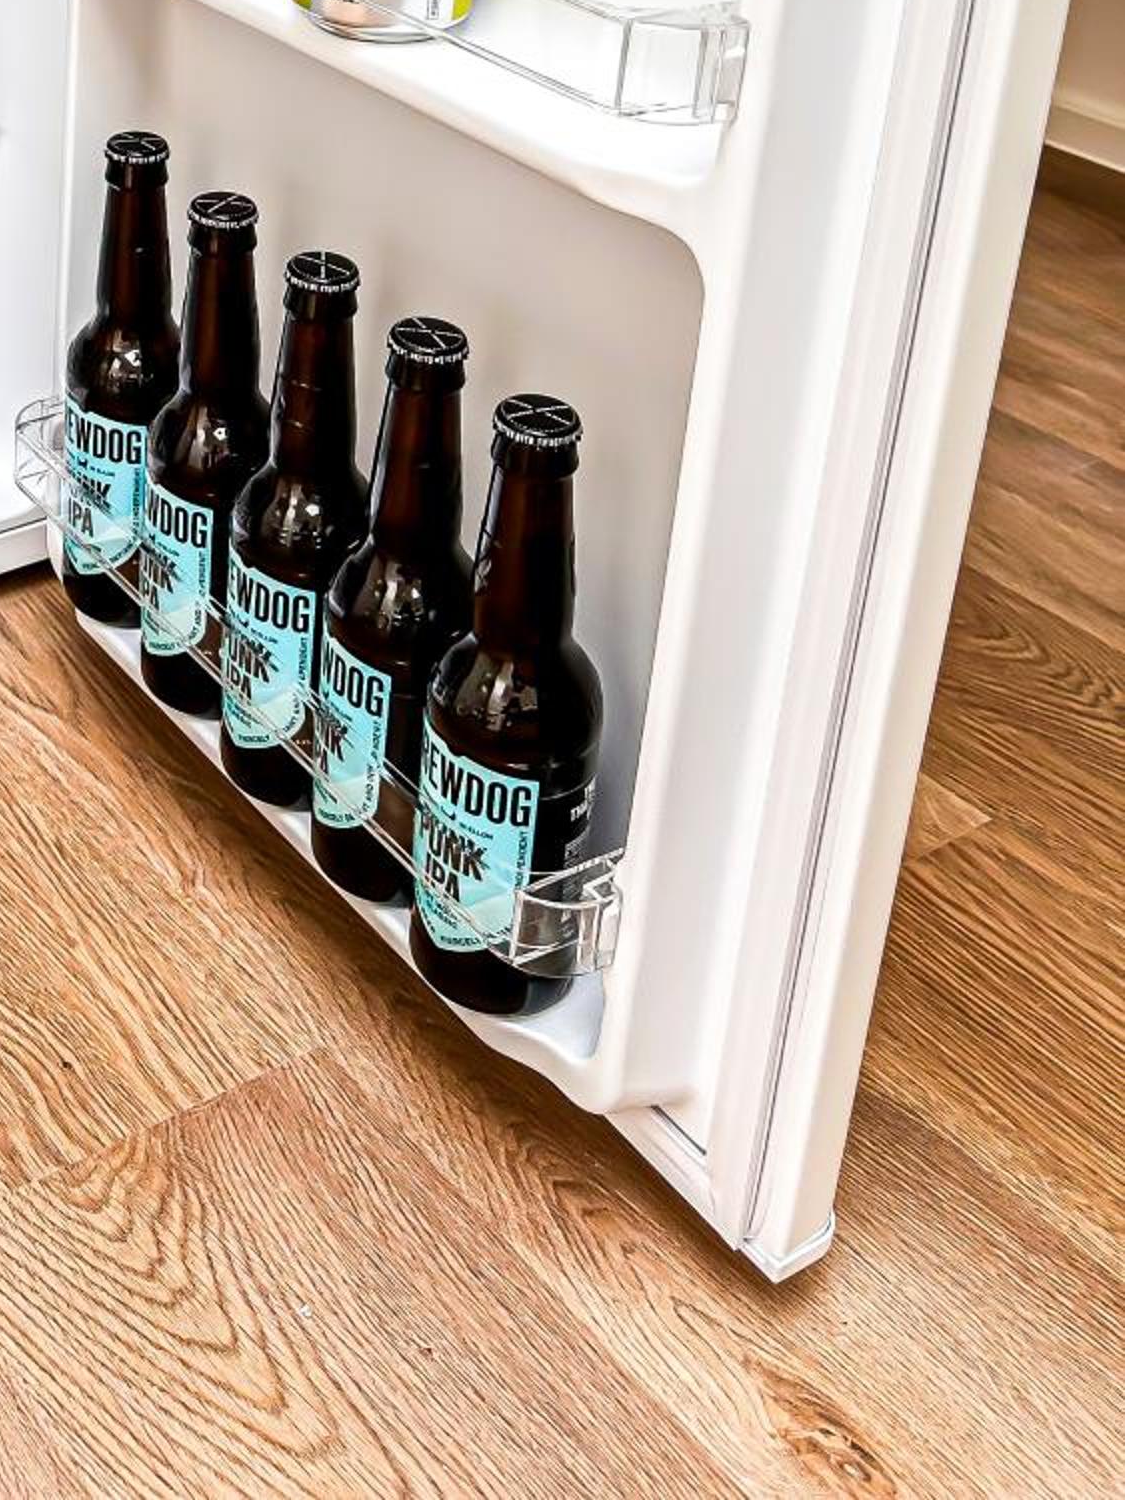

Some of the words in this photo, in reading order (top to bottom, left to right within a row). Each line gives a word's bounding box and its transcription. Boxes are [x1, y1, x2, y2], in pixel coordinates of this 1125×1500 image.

[67, 408, 142, 465] EWDOG
[148, 486, 208, 549] WDOG
[230, 559, 310, 634] EWDOG
[323, 641, 385, 719] WDOG
